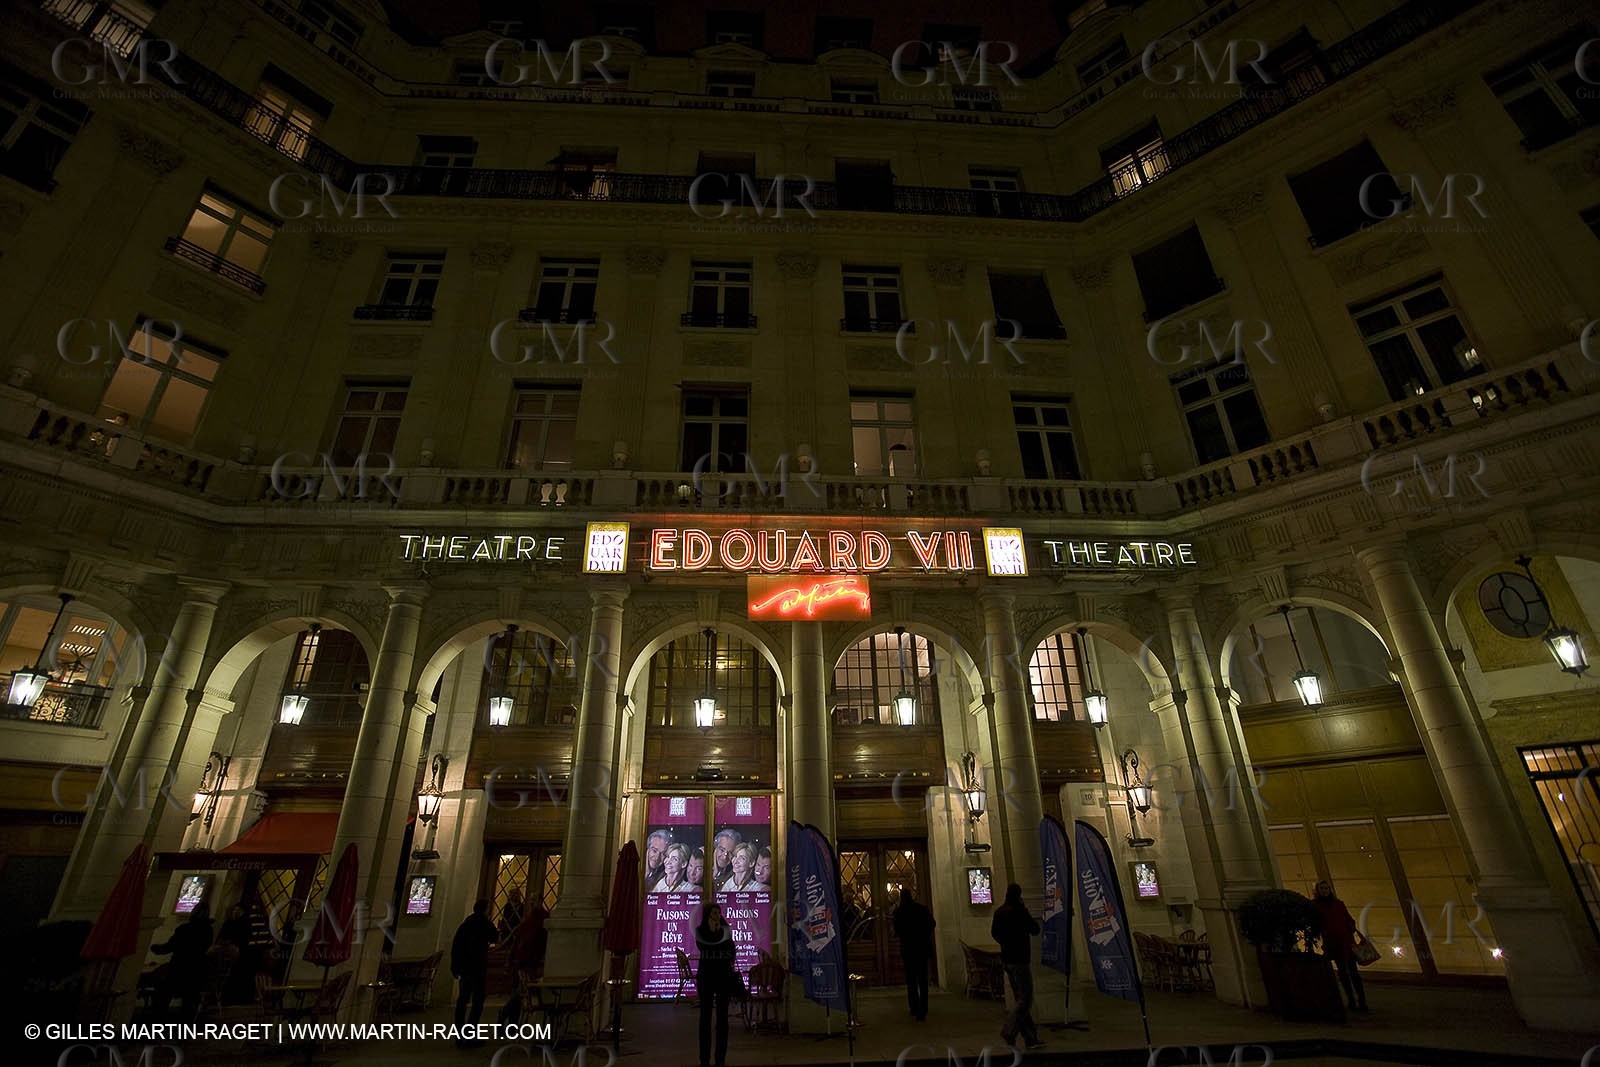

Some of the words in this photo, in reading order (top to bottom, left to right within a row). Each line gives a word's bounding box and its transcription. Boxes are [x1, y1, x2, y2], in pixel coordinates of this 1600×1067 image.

[399, 534, 566, 562] THEATRE
[649, 529, 892, 572] EDOUARD
[906, 530, 975, 573] VII
[1043, 540, 1197, 566] THEATRE
